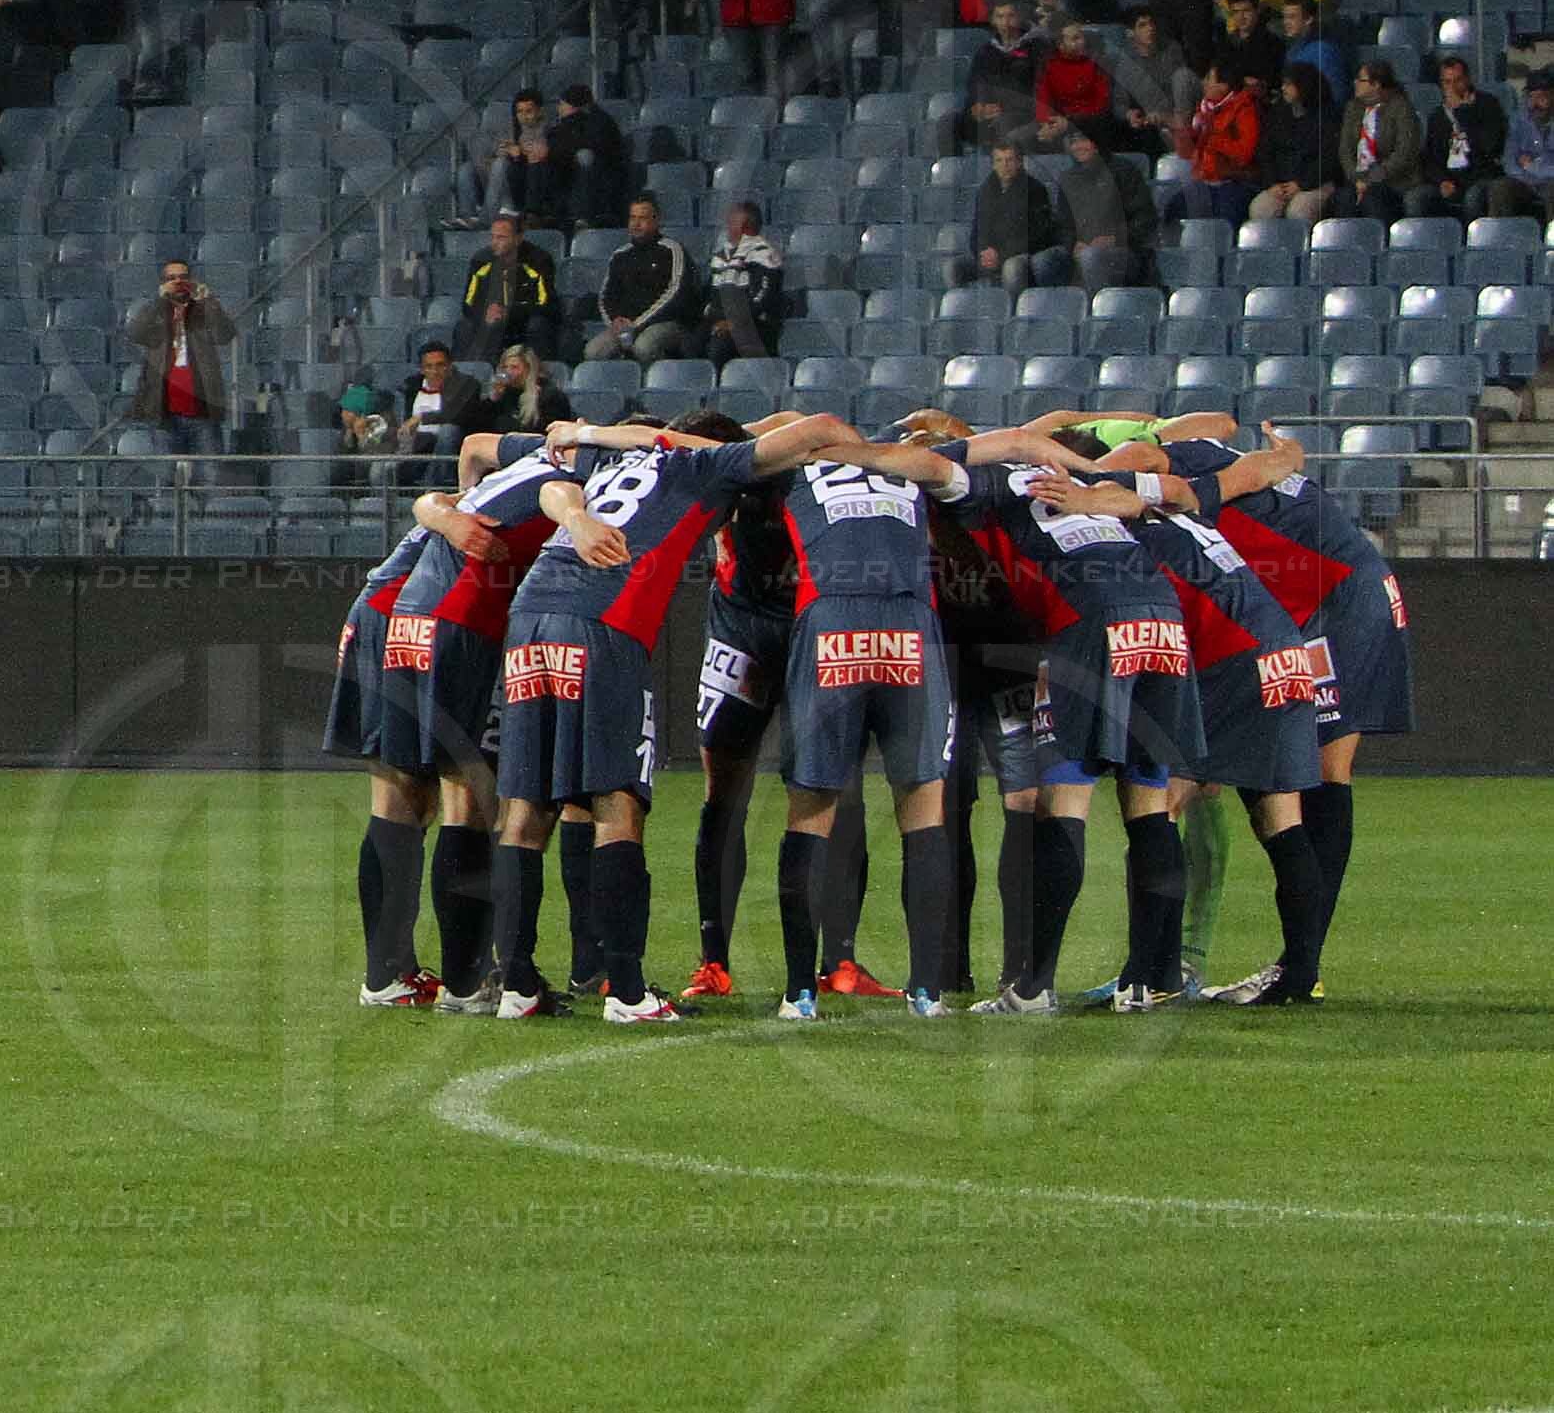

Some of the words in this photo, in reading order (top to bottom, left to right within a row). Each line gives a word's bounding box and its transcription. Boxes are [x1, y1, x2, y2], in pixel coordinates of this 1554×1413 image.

[817, 632, 921, 661] KLEINE
[1106, 621, 1187, 651] KLEINE
[505, 644, 584, 678] KLEINE
[818, 663, 921, 688] ZEITUNG
[1111, 654, 1187, 676] ZEITUNG
